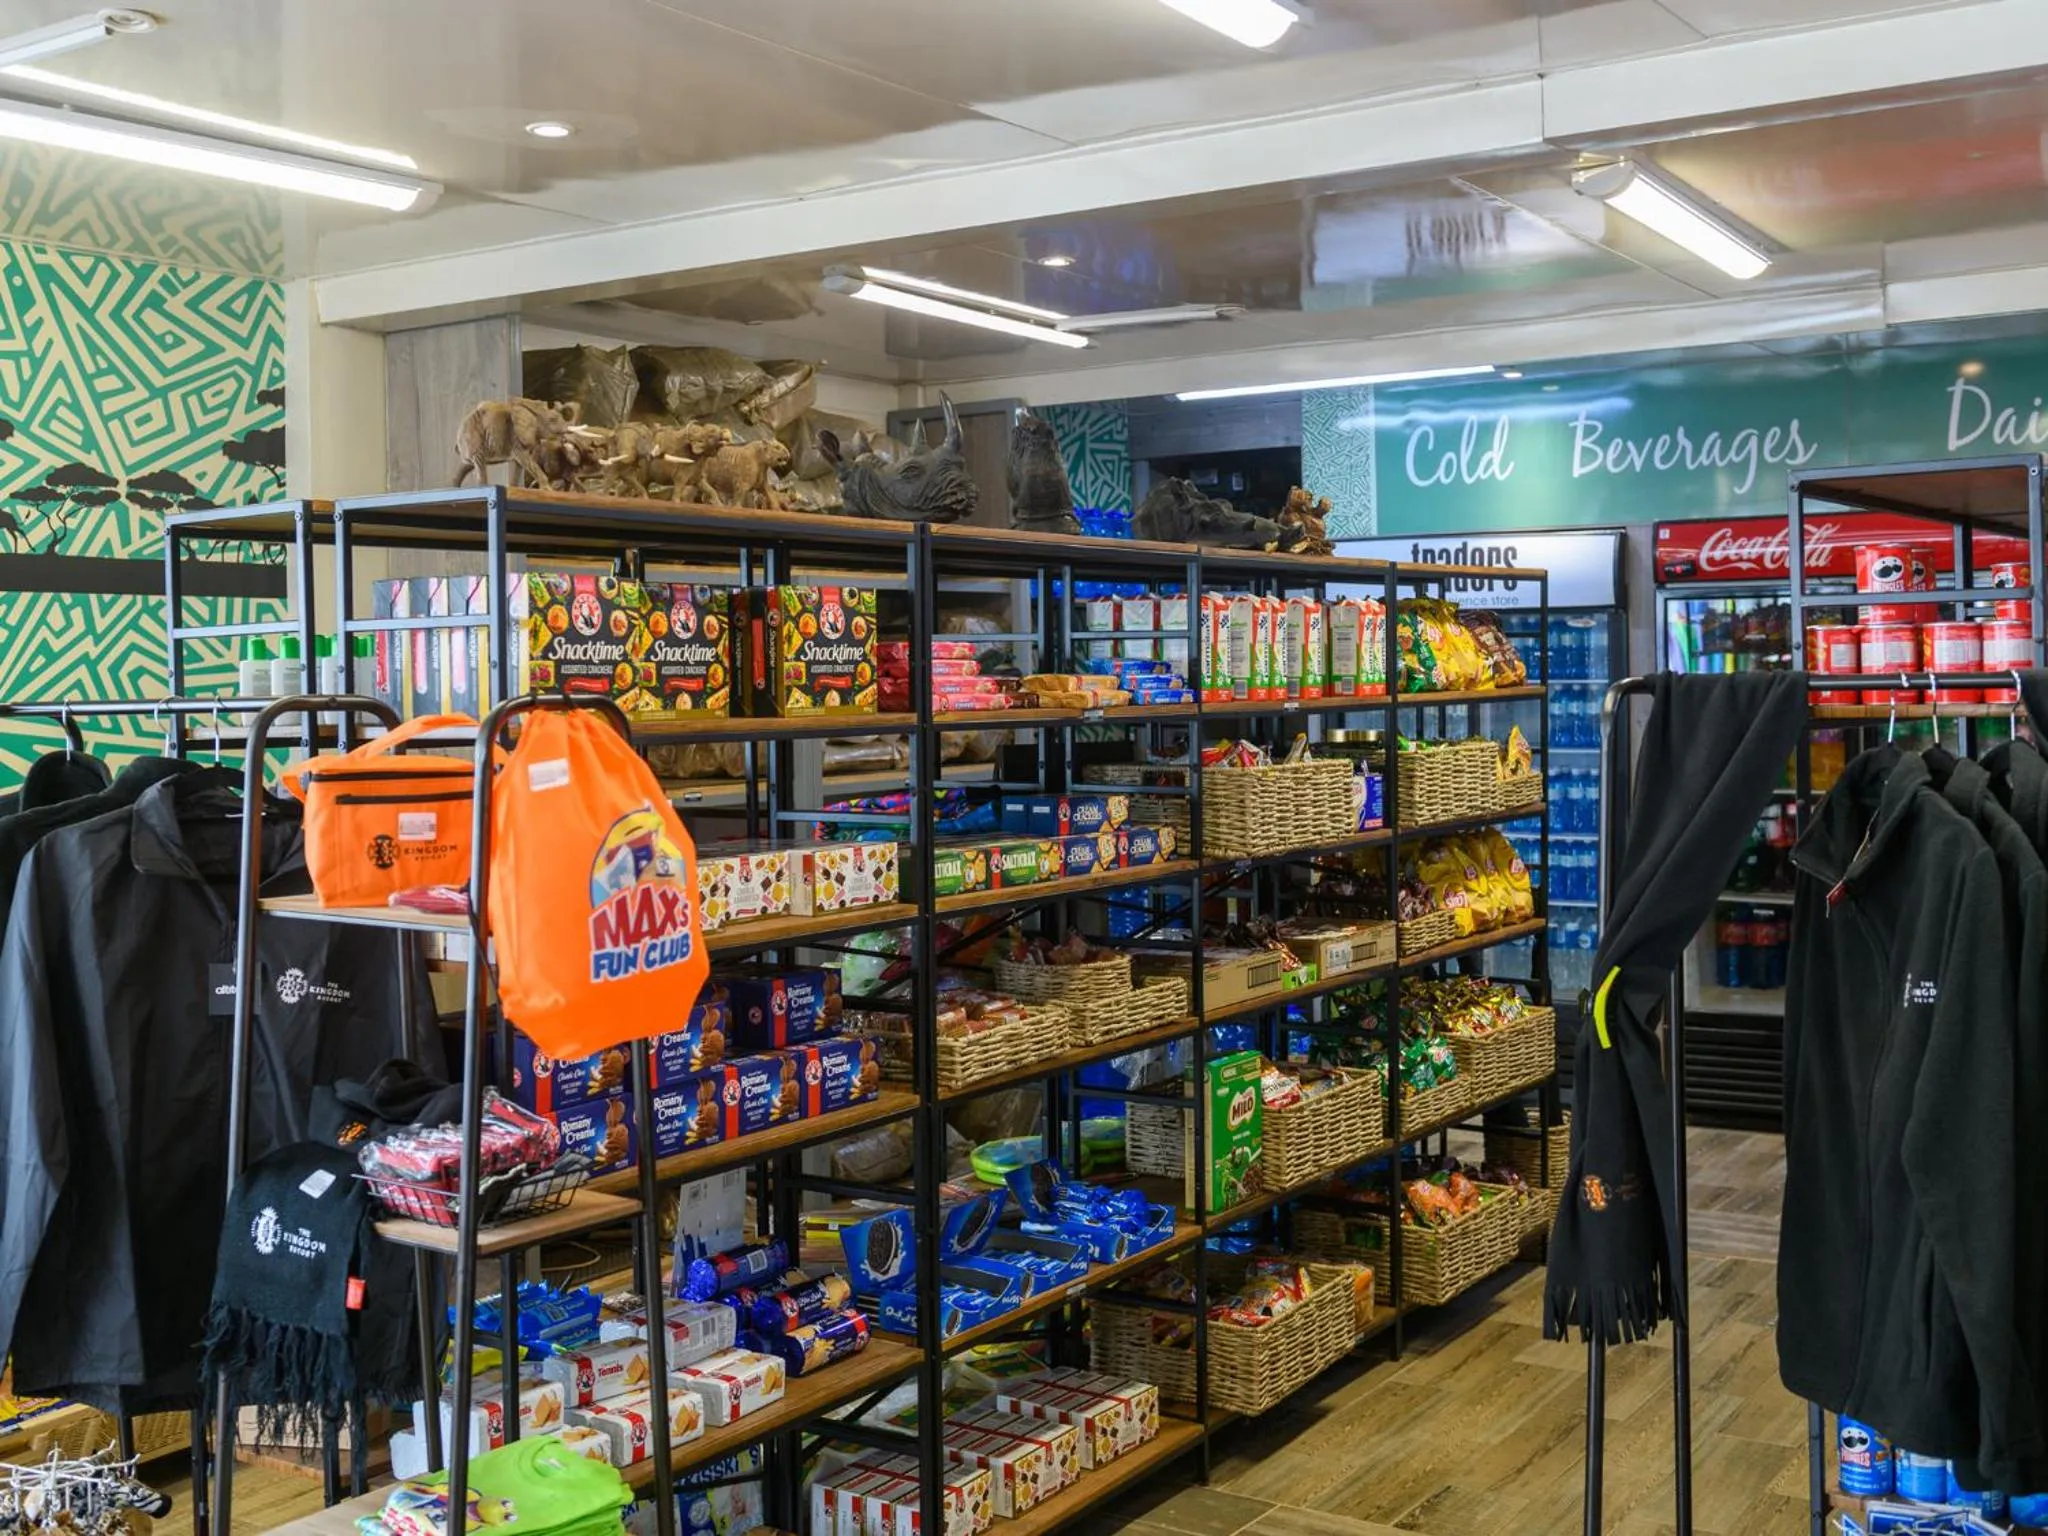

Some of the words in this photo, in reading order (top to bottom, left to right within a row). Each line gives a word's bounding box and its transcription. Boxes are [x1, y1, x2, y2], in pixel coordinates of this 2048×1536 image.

[1406, 414, 1515, 487] Cold
[1569, 409, 1818, 494] Beverages
[1491, 596, 1519, 606] store
[548, 637, 625, 663] Snacktime
[654, 639, 716, 662] Snacktime
[800, 639, 865, 661] Snacktime
[404, 845, 457, 855] KINGDOM
[593, 946, 640, 980] FUN
[644, 932, 691, 970] CLUB
[309, 986, 351, 998] KINGDOM
[823, 1055, 848, 1068] Romany
[740, 1072, 768, 1089] Romany
[745, 1083, 772, 1098] Creams
[653, 1094, 684, 1112] Romany
[1232, 1096, 1254, 1121] MILO
[658, 1105, 687, 1120] Creams
[560, 1117, 592, 1135] Romany
[566, 1127, 597, 1144] Creams
[299, 1227, 311, 1238] THE
[283, 1231, 327, 1254] KINGDOM
[598, 1364, 624, 1377] Tennis
[743, 1375, 762, 1388] Tennis
